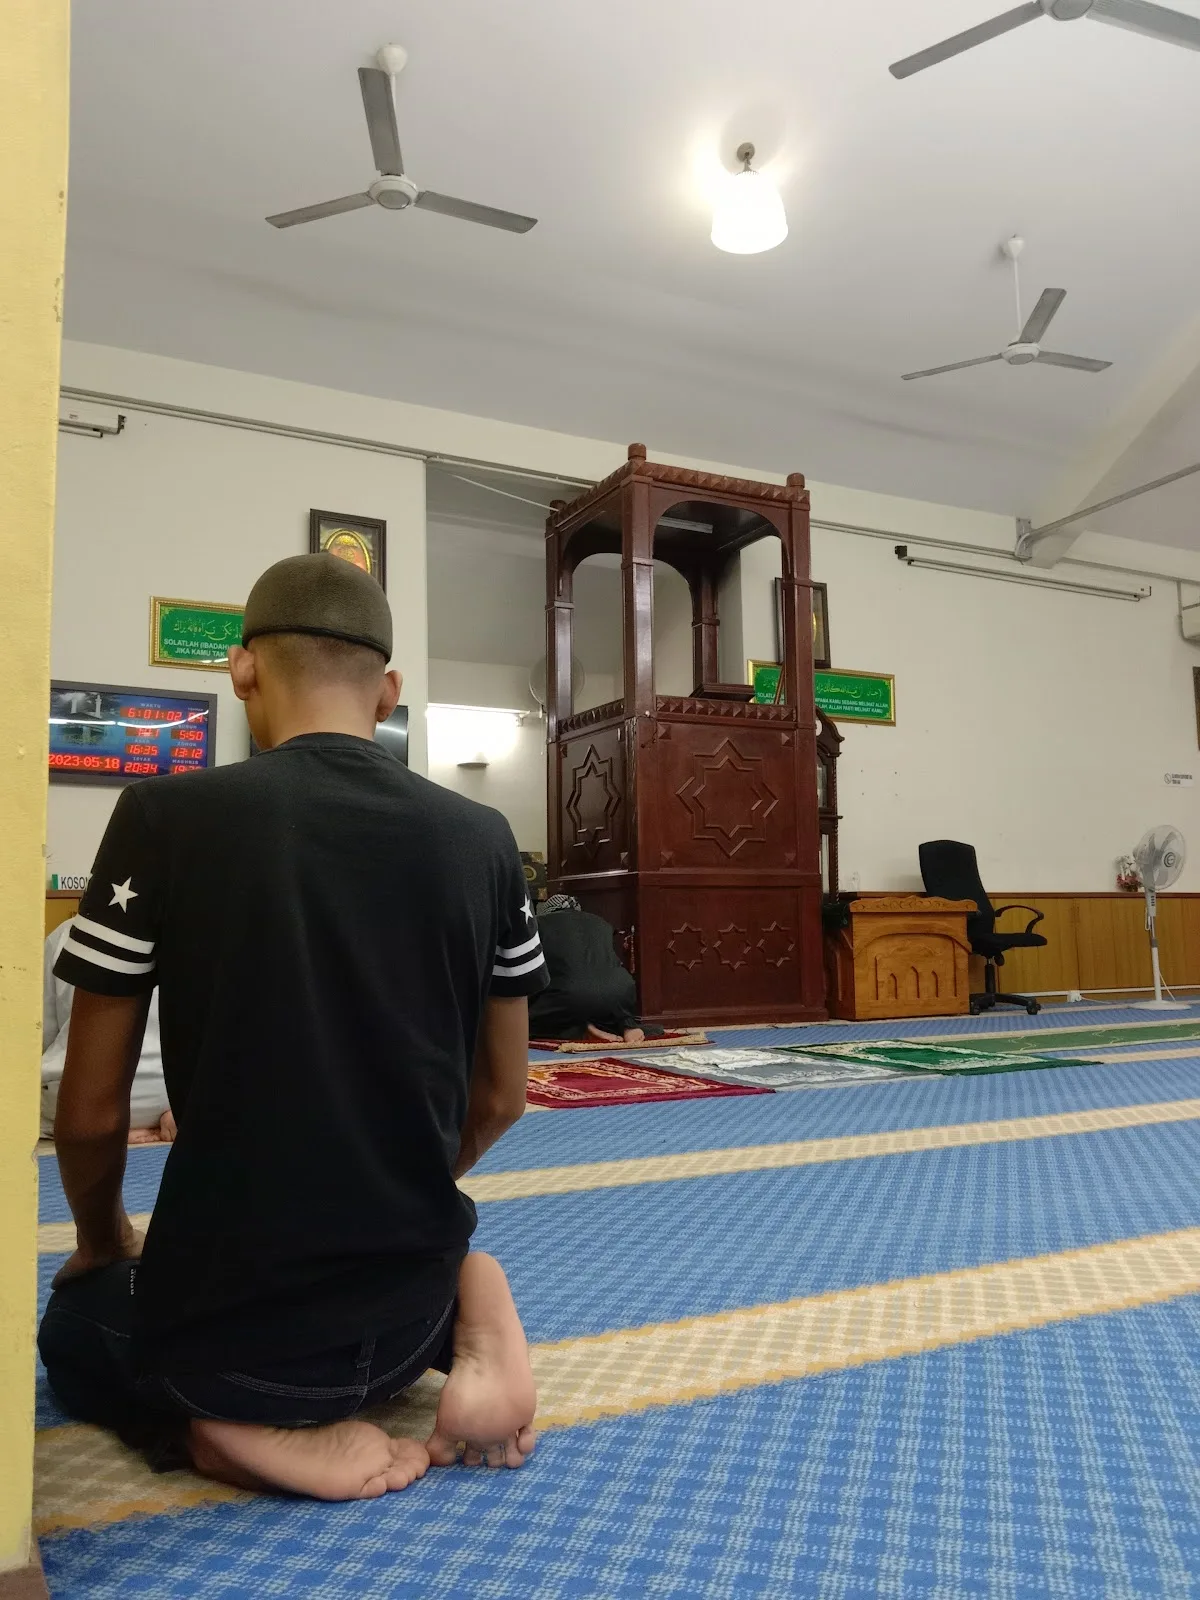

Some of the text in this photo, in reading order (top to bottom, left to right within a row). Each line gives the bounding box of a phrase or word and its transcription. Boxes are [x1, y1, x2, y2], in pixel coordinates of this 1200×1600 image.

[163, 639, 199, 648] SOLATLAH
[212, 650, 225, 658] TAK
[180, 729, 203, 741] 5:50
[129, 744, 158, 756] 16:35
[174, 747, 203, 759] 13:12
[48, 754, 120, 770] 2023-05-18
[124, 762, 158, 774] 20:34
